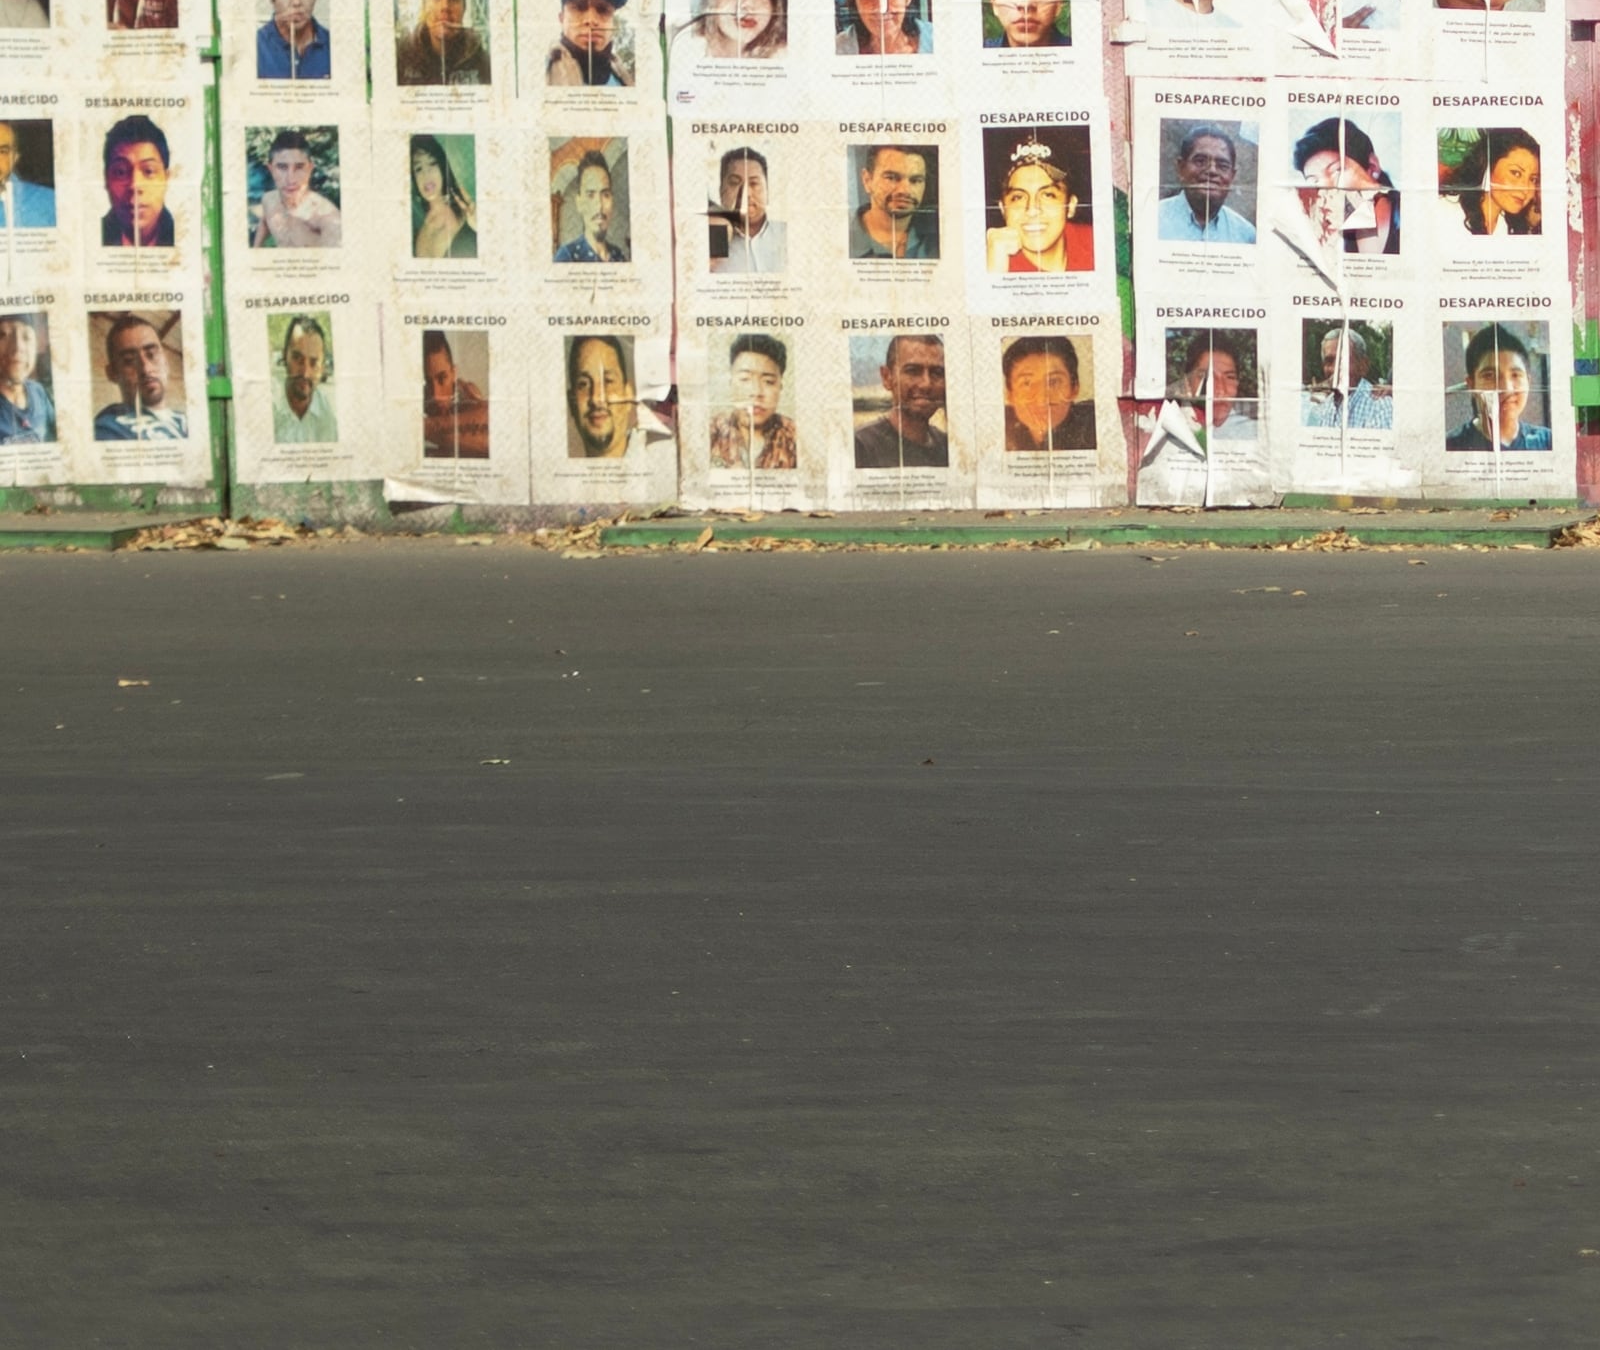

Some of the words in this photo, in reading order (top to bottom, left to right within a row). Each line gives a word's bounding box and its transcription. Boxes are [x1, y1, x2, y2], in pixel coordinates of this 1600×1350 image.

[0, 94, 59, 106] ARECIDO
[84, 97, 187, 109] DESAPARECIDO
[1154, 92, 1266, 108] DESAPARECIDO
[1432, 95, 1544, 107] DESAPARECIDA
[979, 110, 1090, 124] DESAPARECIDO
[691, 122, 800, 134] DESAPARECIDO
[839, 122, 947, 134] DESAPARECIDO
[83, 292, 184, 305] DESAPARECIDO
[244, 293, 351, 309] DESAPARECIDO
[1439, 296, 1552, 308] DESAPARECIDO
[1156, 307, 1267, 319] DESAPARECIDO
[403, 315, 507, 326] DESAPARECIDO
[547, 315, 652, 327] DESAPARECIDO
[695, 315, 805, 327] DESAPARECIDO
[841, 316, 950, 330] DESAPARECIDO
[991, 315, 1100, 328] DESAPARECIDO
